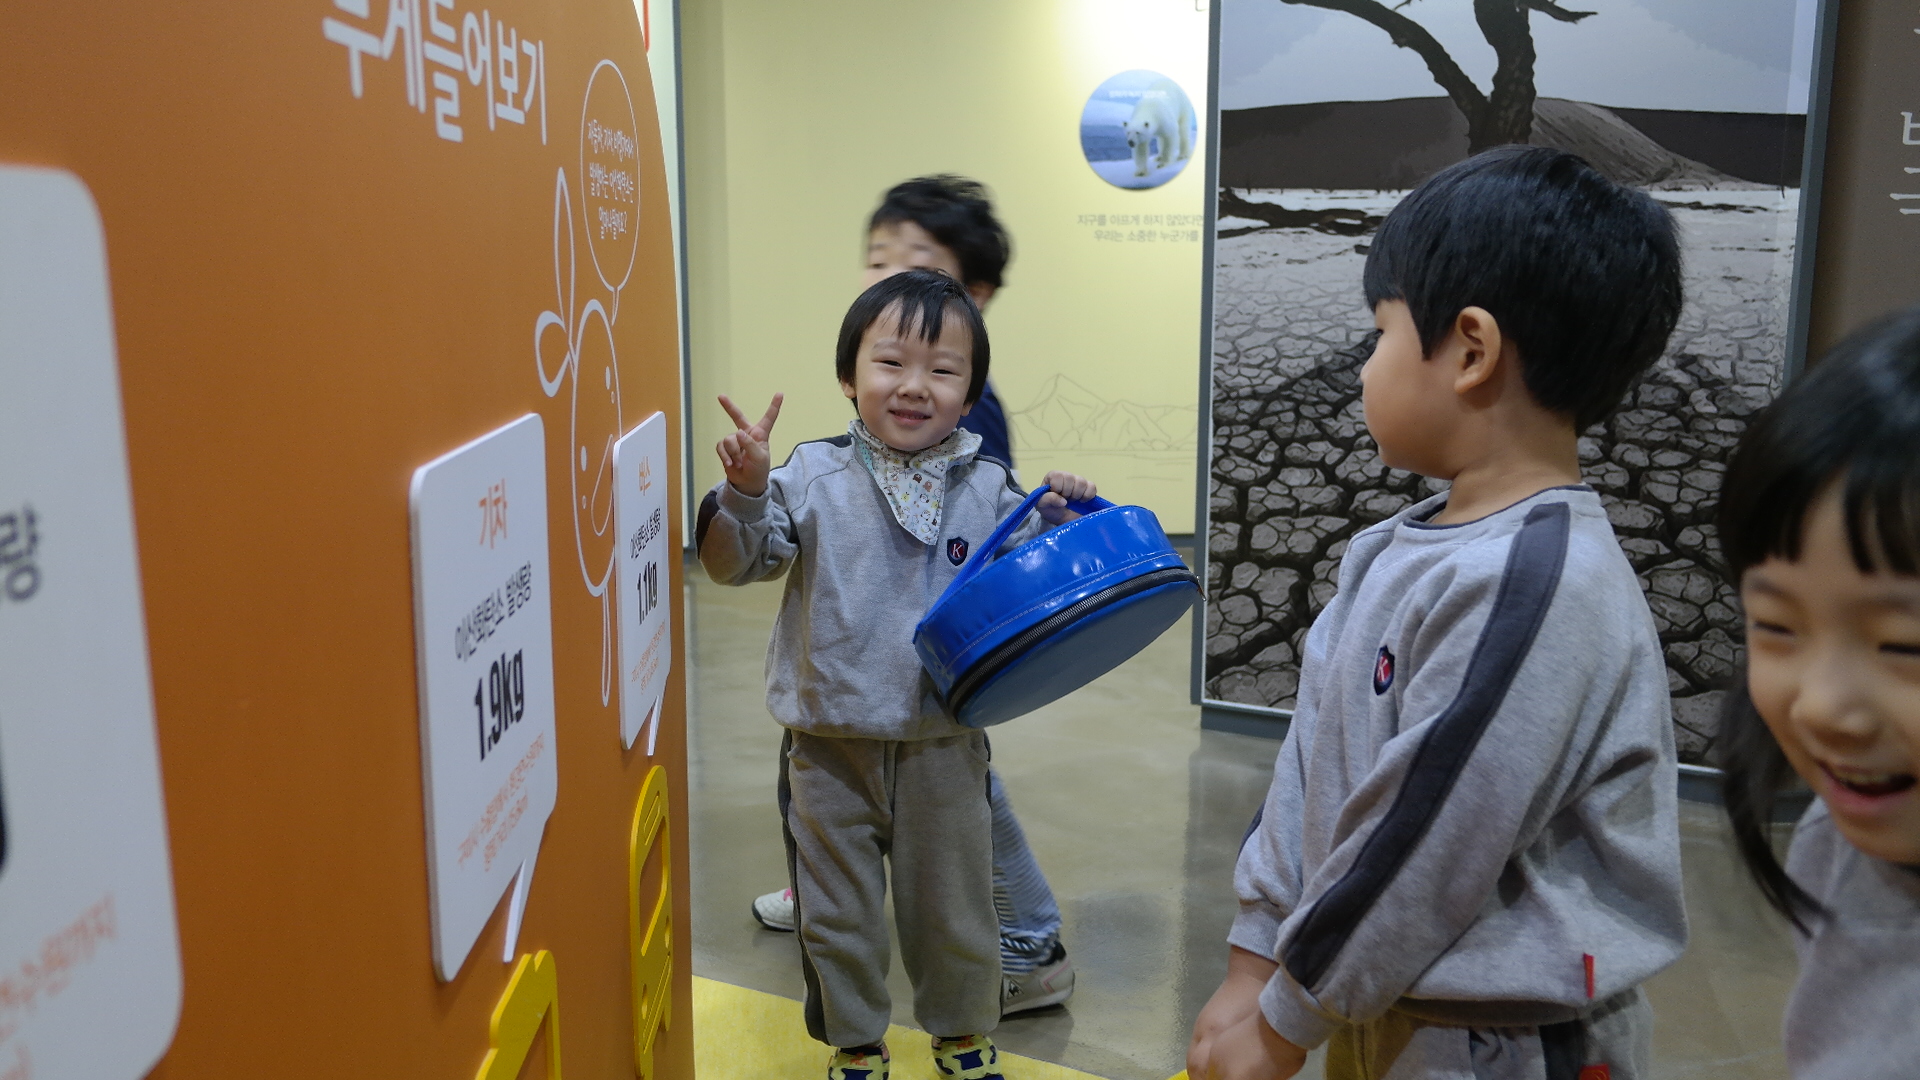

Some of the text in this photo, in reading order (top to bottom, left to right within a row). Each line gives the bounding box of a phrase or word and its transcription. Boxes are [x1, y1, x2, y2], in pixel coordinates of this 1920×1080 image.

[1077, 213, 1107, 228] 지구를
[1110, 213, 1140, 228] 아프게
[1143, 213, 1164, 227] 하지
[1094, 230, 1124, 243] 우리는
[479, 478, 508, 550] 기차
[629, 505, 661, 561] 이산화탄소 발생량
[952, 543, 963, 558] K
[455, 560, 532, 663] 이산화탄소 발생량
[636, 560, 658, 626] 1.1kg
[474, 647, 525, 762] 1.9kg
